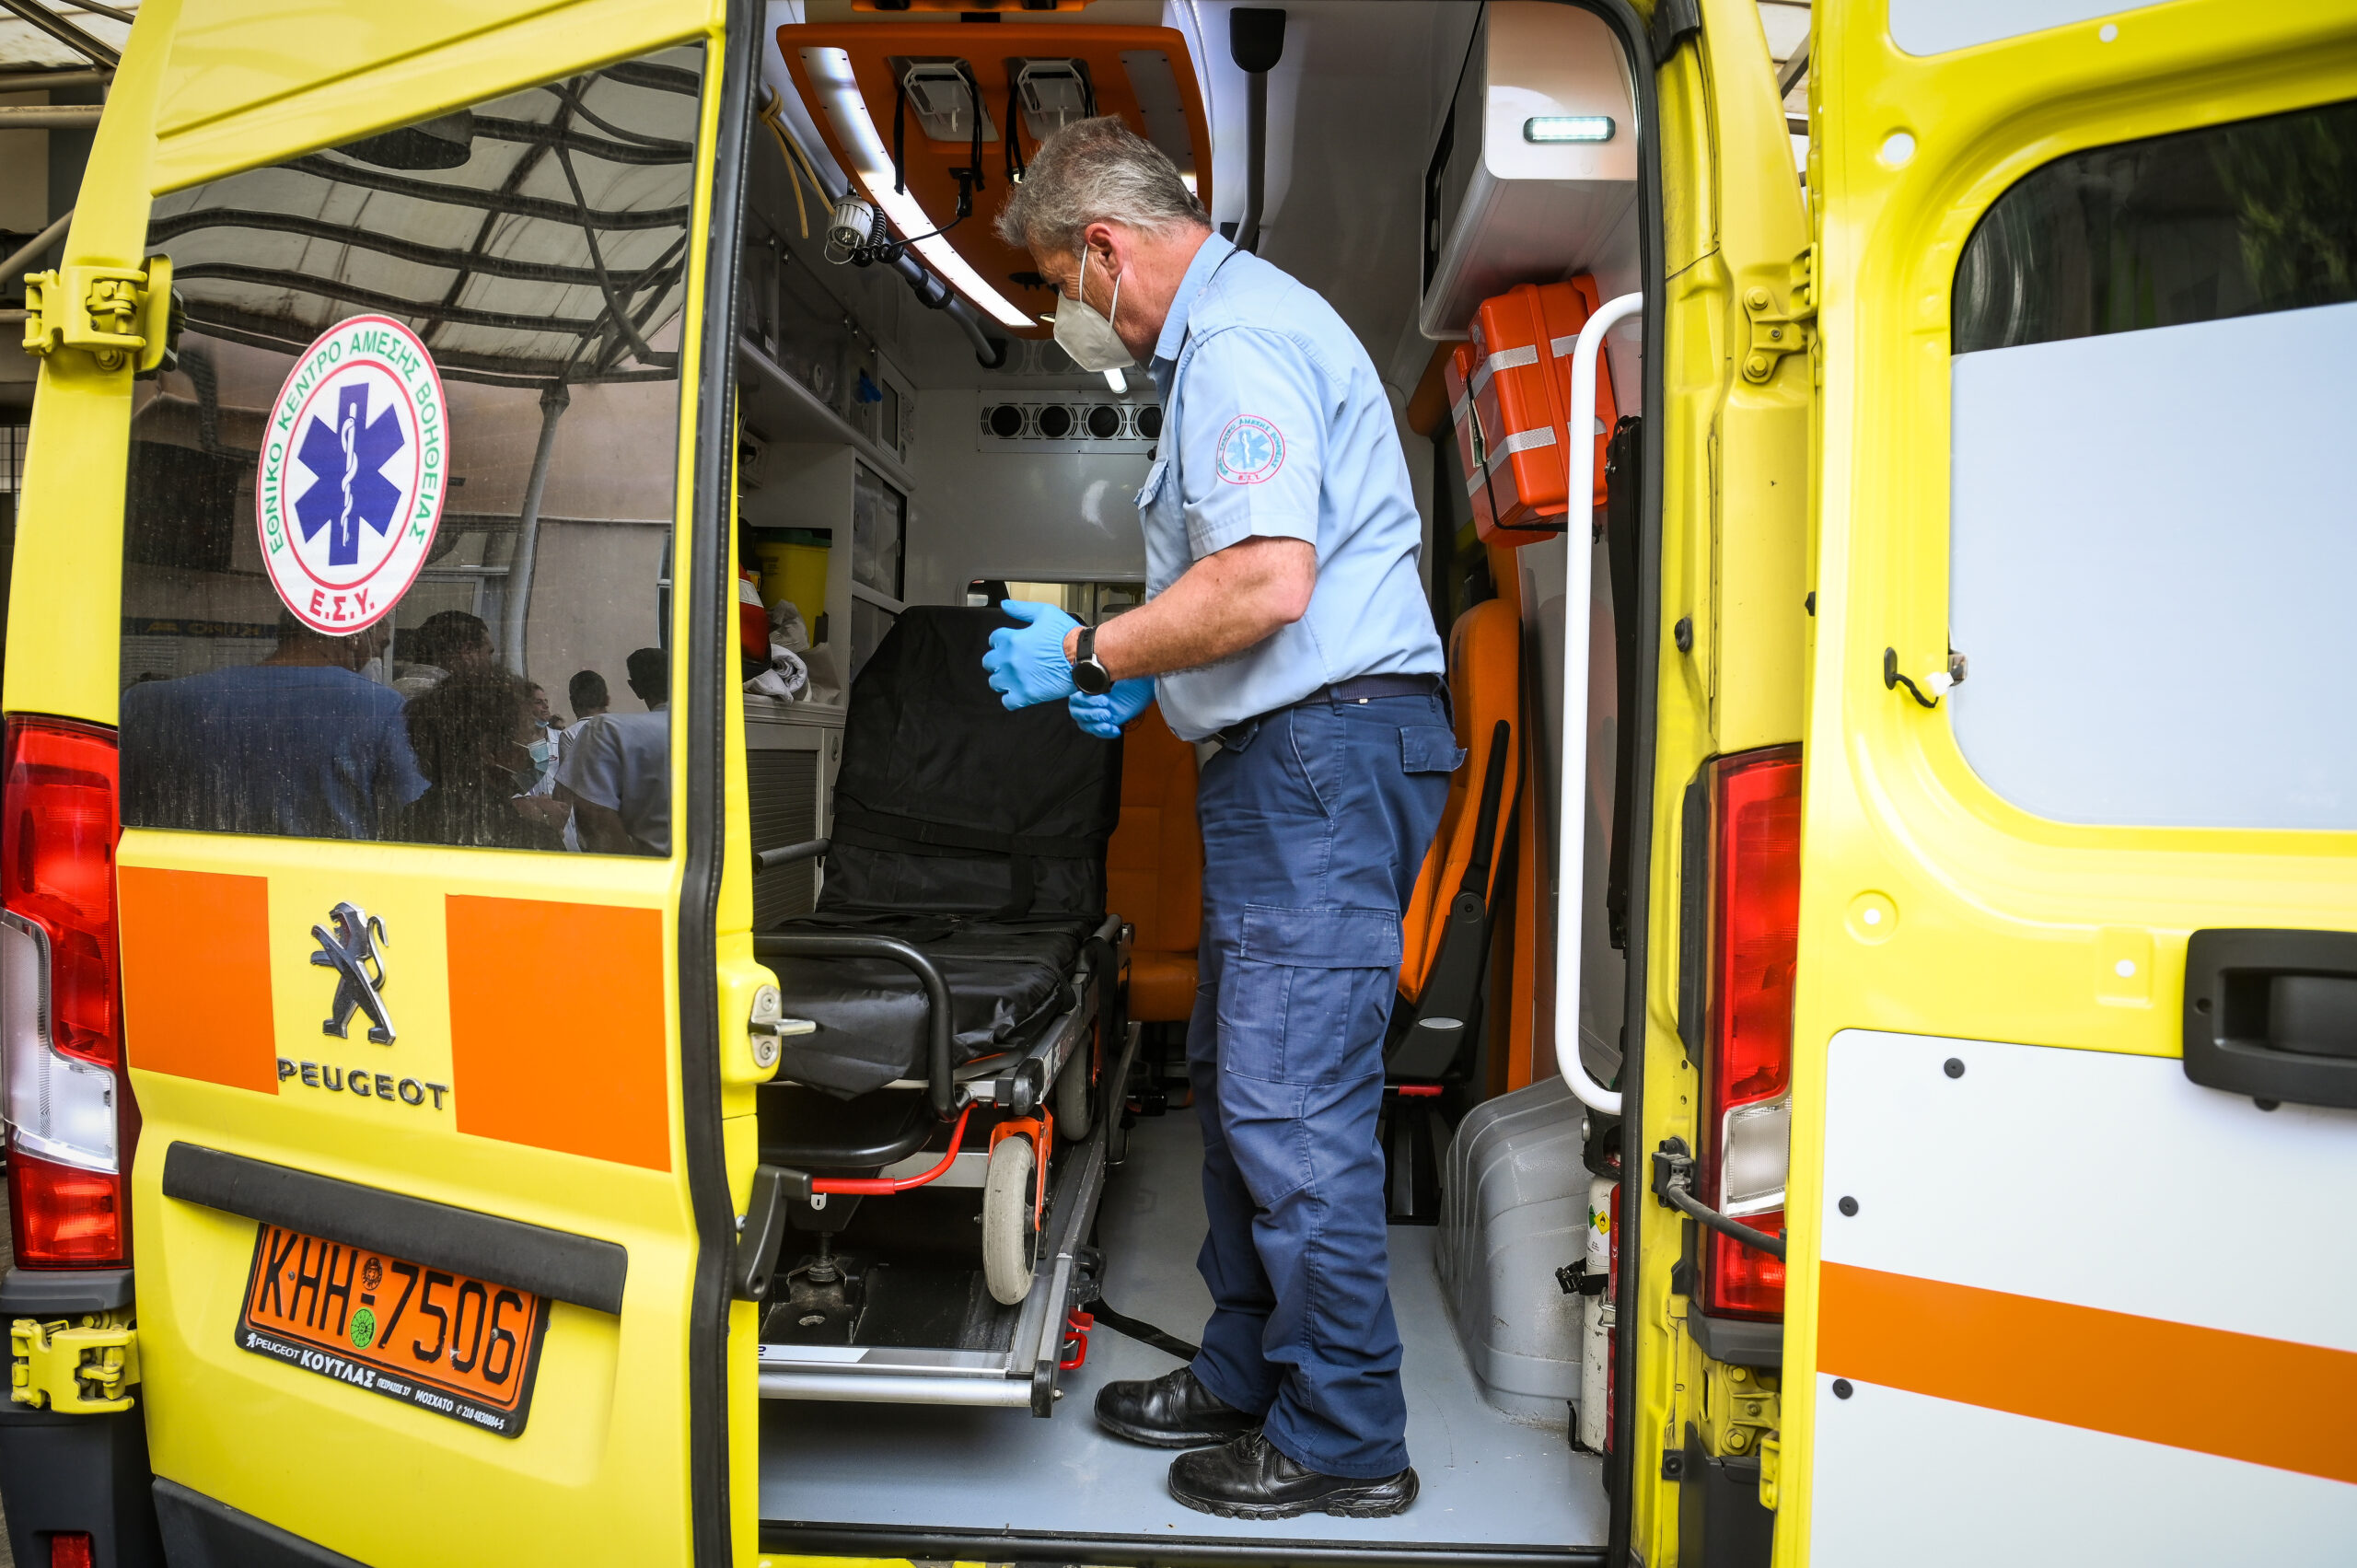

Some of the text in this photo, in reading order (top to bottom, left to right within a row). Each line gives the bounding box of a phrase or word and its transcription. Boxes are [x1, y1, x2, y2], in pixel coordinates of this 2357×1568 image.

[264, 331, 440, 554] ΕΘΝΙΚΟ ΚΕΝΤΡΟ ΑΜΕΣΗΣ ΒΟΗΘΕΙΑΣ
[276, 1057, 450, 1110] PEUGEOT
[255, 1337, 301, 1360] PEUGEOT
[299, 1349, 377, 1388] ΚΟΥΤΛΑΣ
[414, 1389, 454, 1412] ΜΟΣΧΑΤΟ
[461, 1406, 475, 1419] 210
